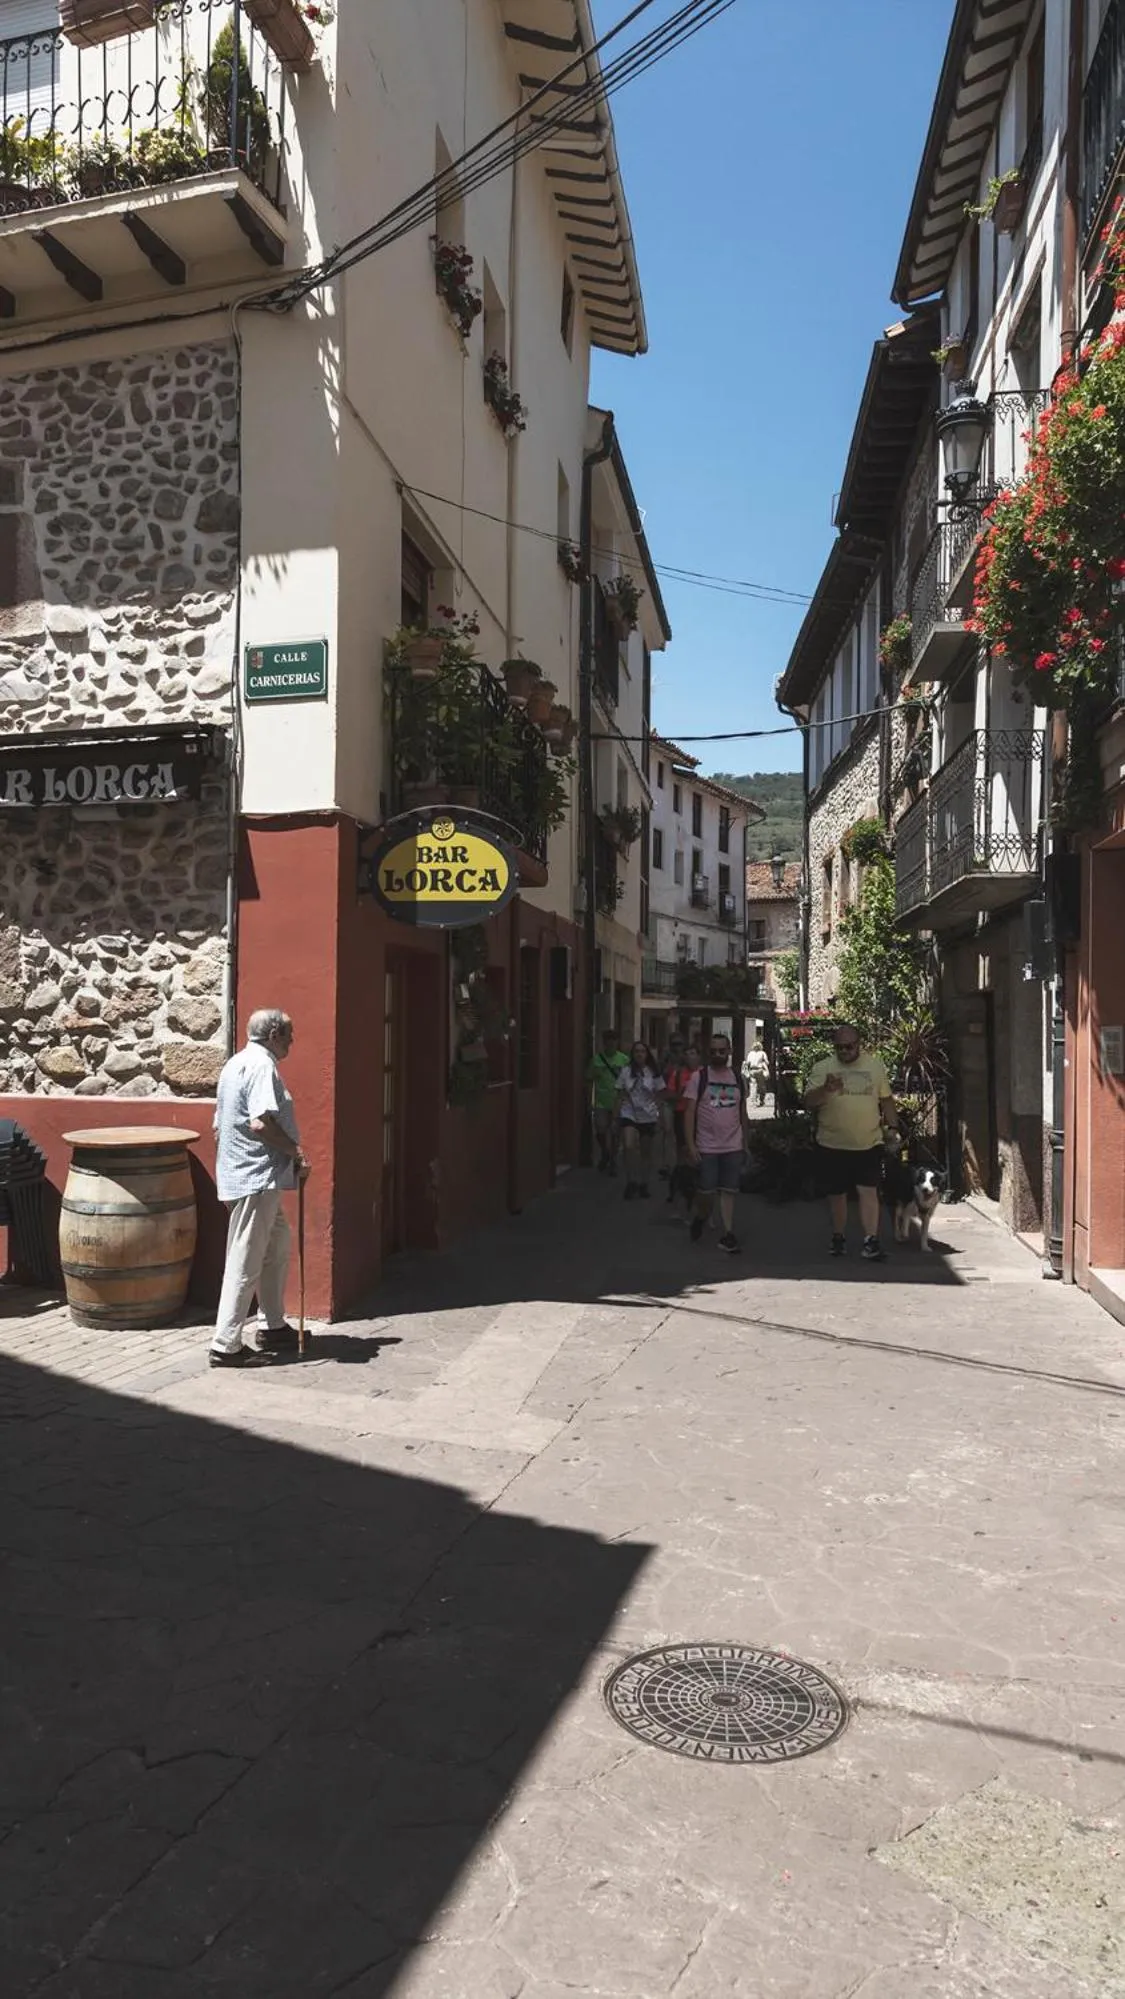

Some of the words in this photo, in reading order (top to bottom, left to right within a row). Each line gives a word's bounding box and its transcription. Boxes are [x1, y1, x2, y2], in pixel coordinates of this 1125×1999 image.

[274, 652, 308, 663] CALLE
[249, 672, 321, 688] CARNICERIAS
[42, 763, 177, 803] LORCA
[416, 845, 470, 864] BAR
[383, 868, 502, 894] LORCA
